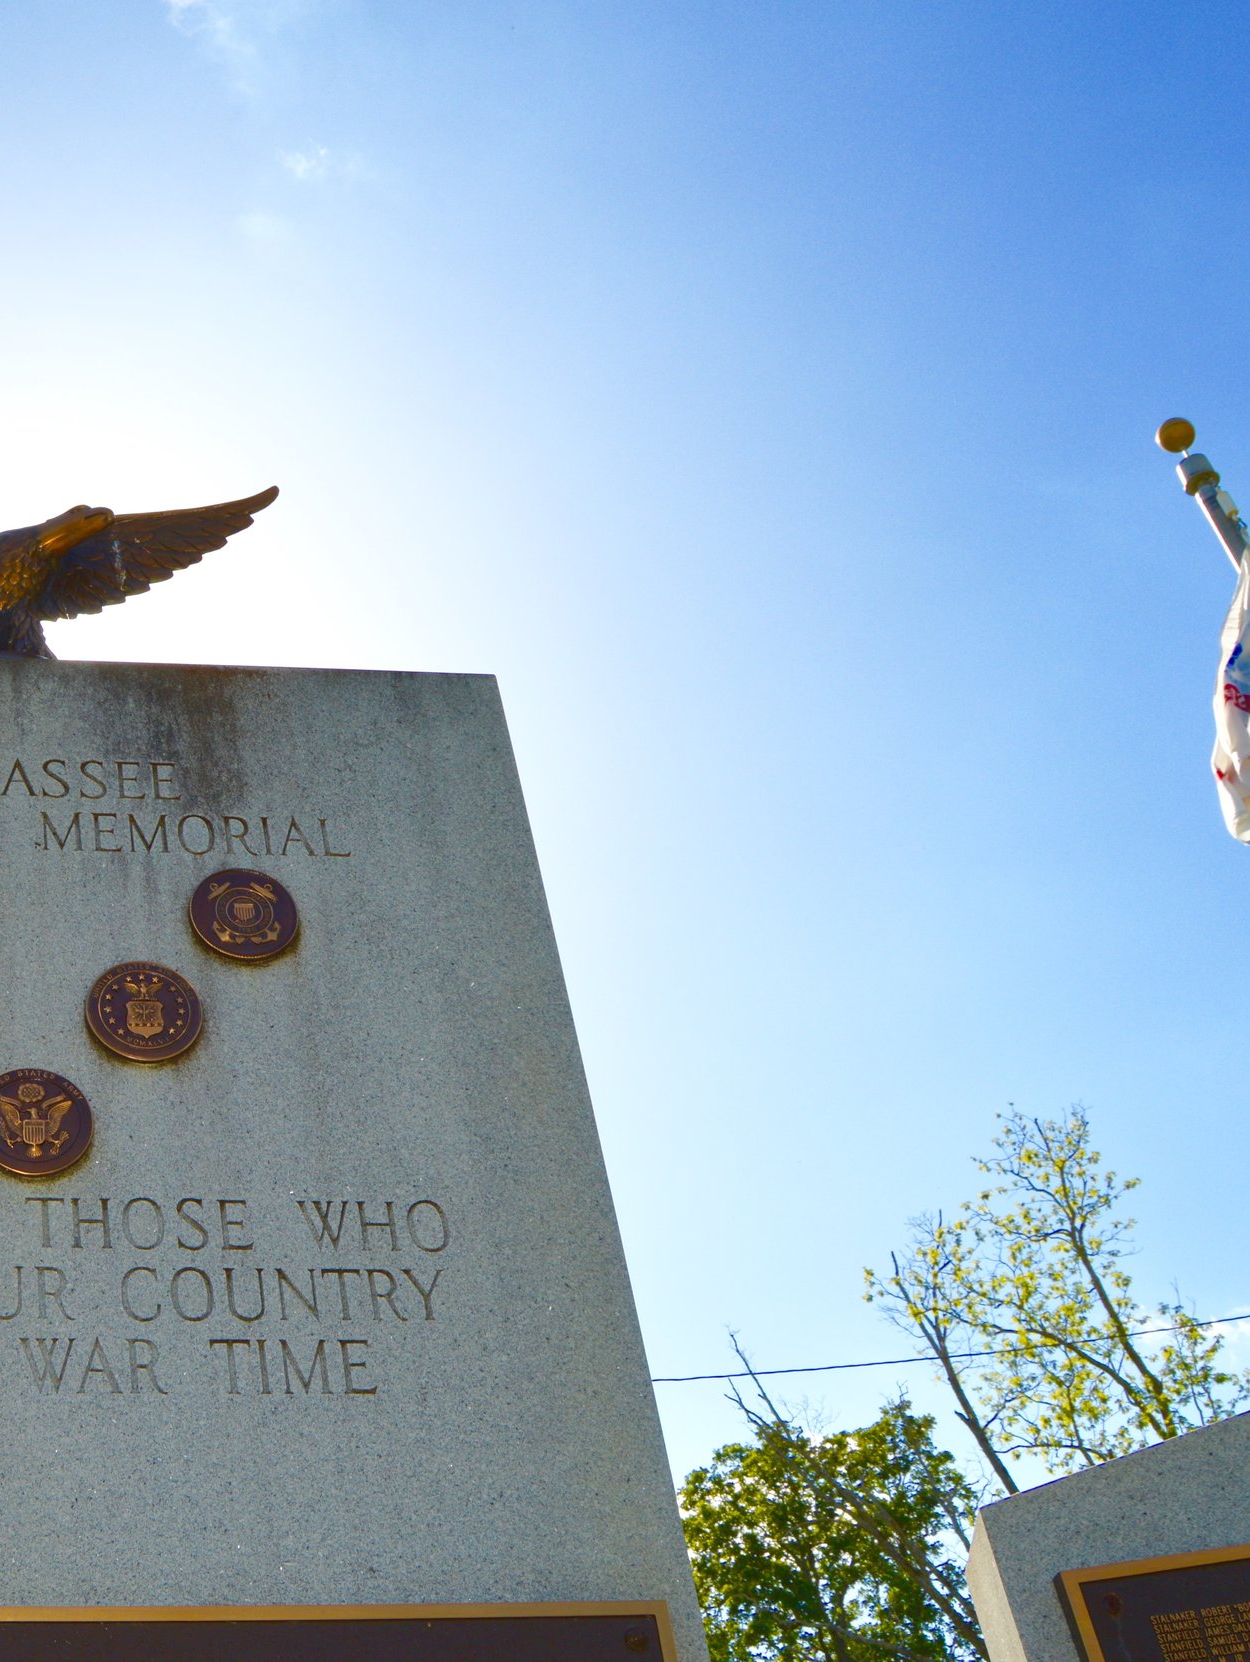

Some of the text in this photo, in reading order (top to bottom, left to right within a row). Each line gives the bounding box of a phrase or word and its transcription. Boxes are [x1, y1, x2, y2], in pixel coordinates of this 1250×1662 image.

[41, 811, 352, 858] MEMORIAL
[17, 1069, 55, 1081] STATES
[62, 1081, 84, 1099] ARMY
[25, 1197, 254, 1251] THOSE
[296, 1199, 449, 1253] WHO
[121, 1266, 445, 1322] COUNTRY
[19, 1337, 168, 1395] WAR
[209, 1338, 378, 1396] TIME
[1200, 1605, 1231, 1617] ROBERT
[1204, 1614, 1236, 1626] GEORGE
[1204, 1625, 1230, 1637] JAMES
[1207, 1634, 1241, 1646] SAMUEL
[1210, 1643, 1246, 1655] WILLIAM
